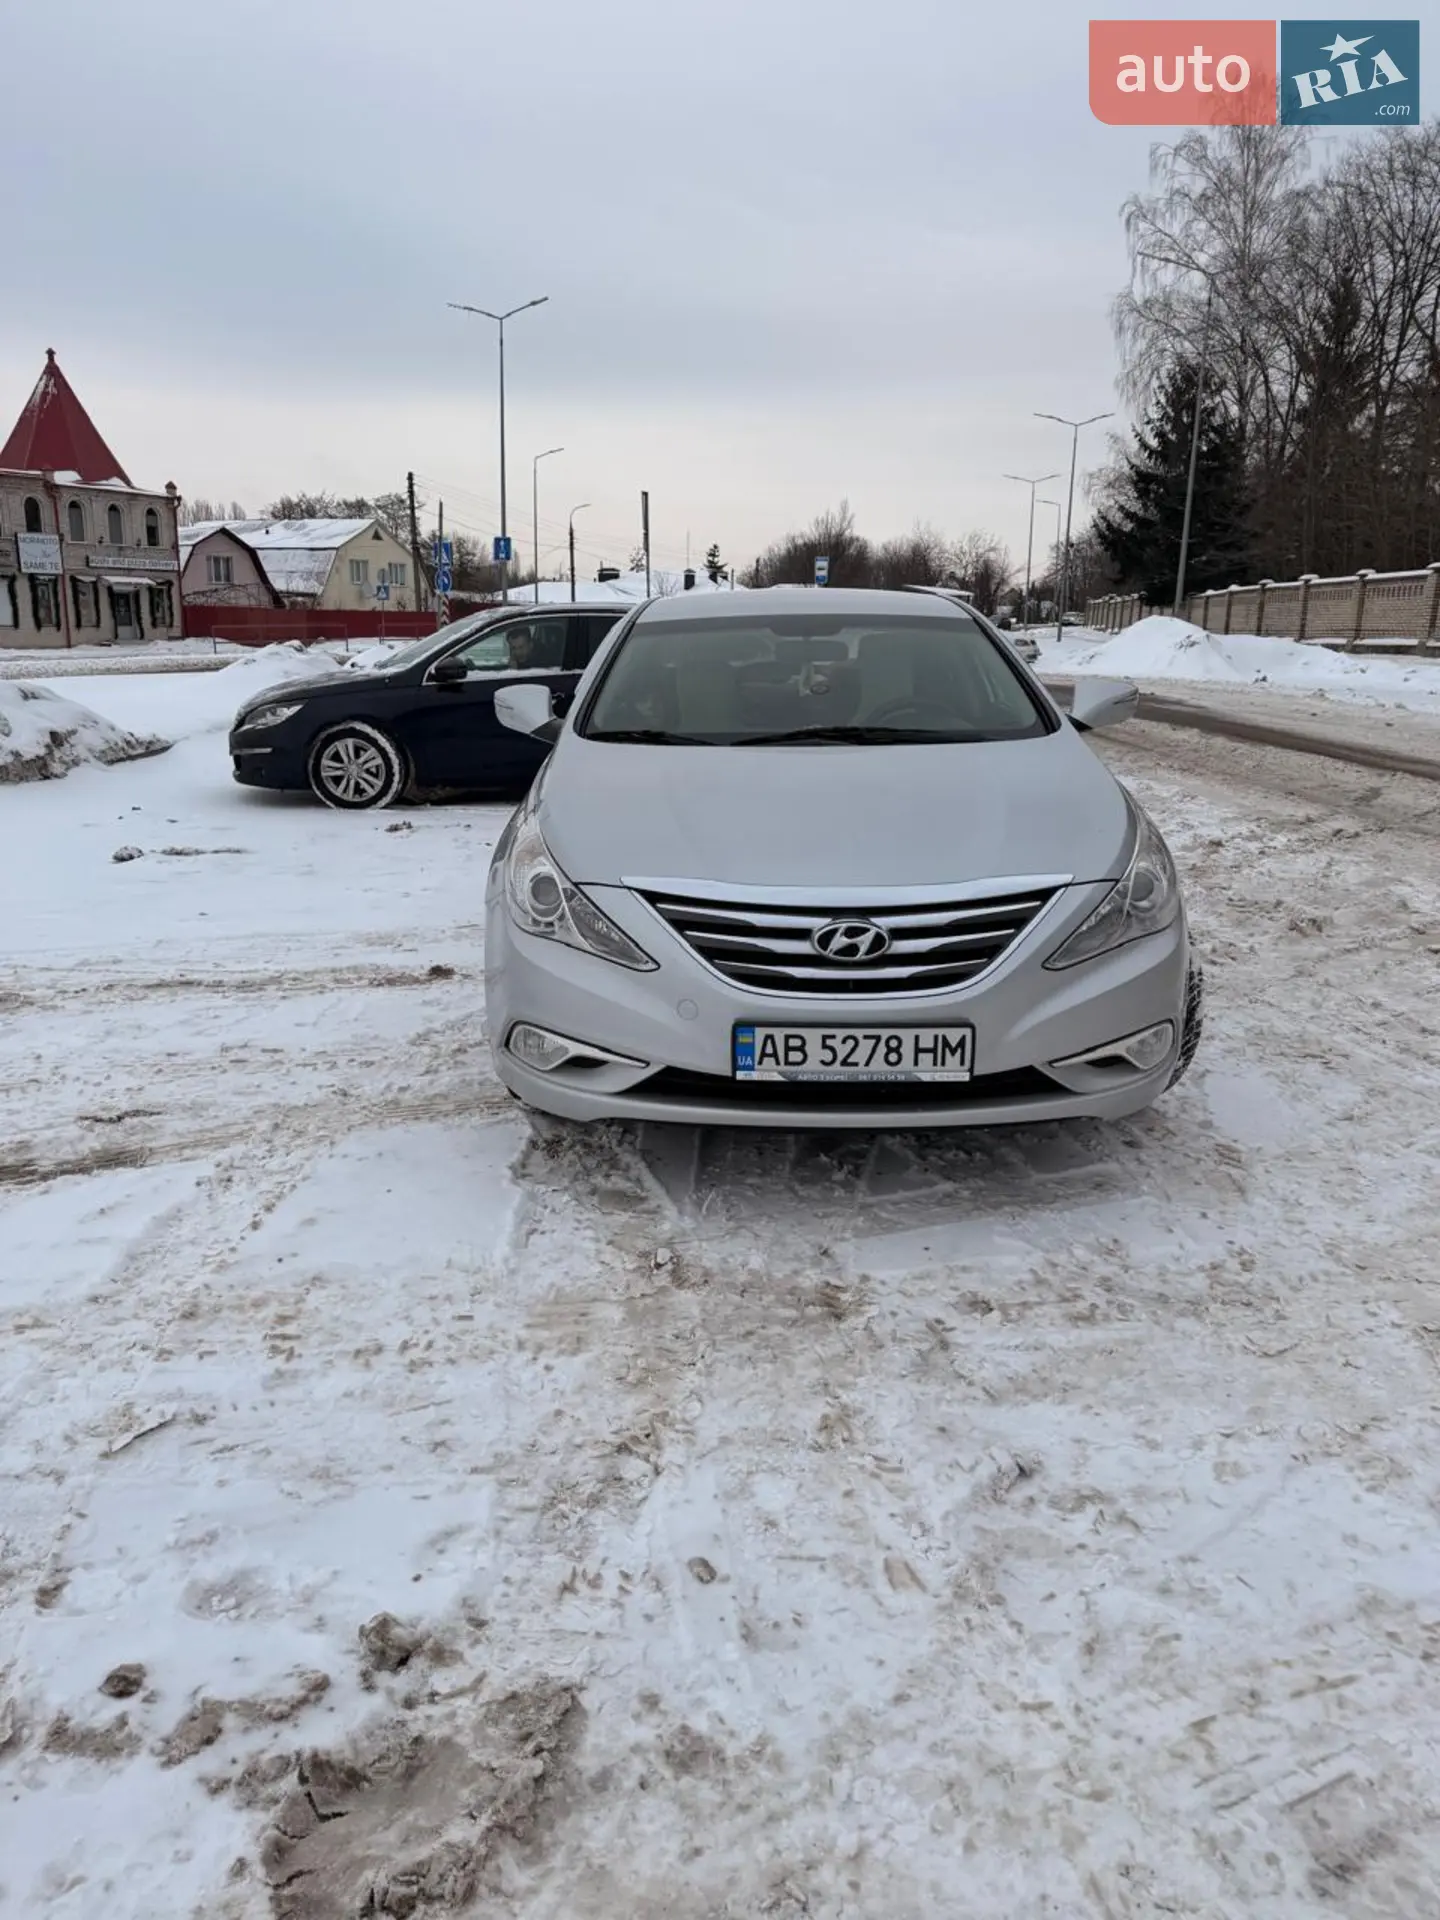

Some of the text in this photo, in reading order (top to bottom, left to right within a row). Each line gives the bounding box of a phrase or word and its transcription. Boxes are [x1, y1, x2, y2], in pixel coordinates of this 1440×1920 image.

[737, 1055, 753, 1067] UA
[757, 1033, 967, 1068] AB 5278 HM
